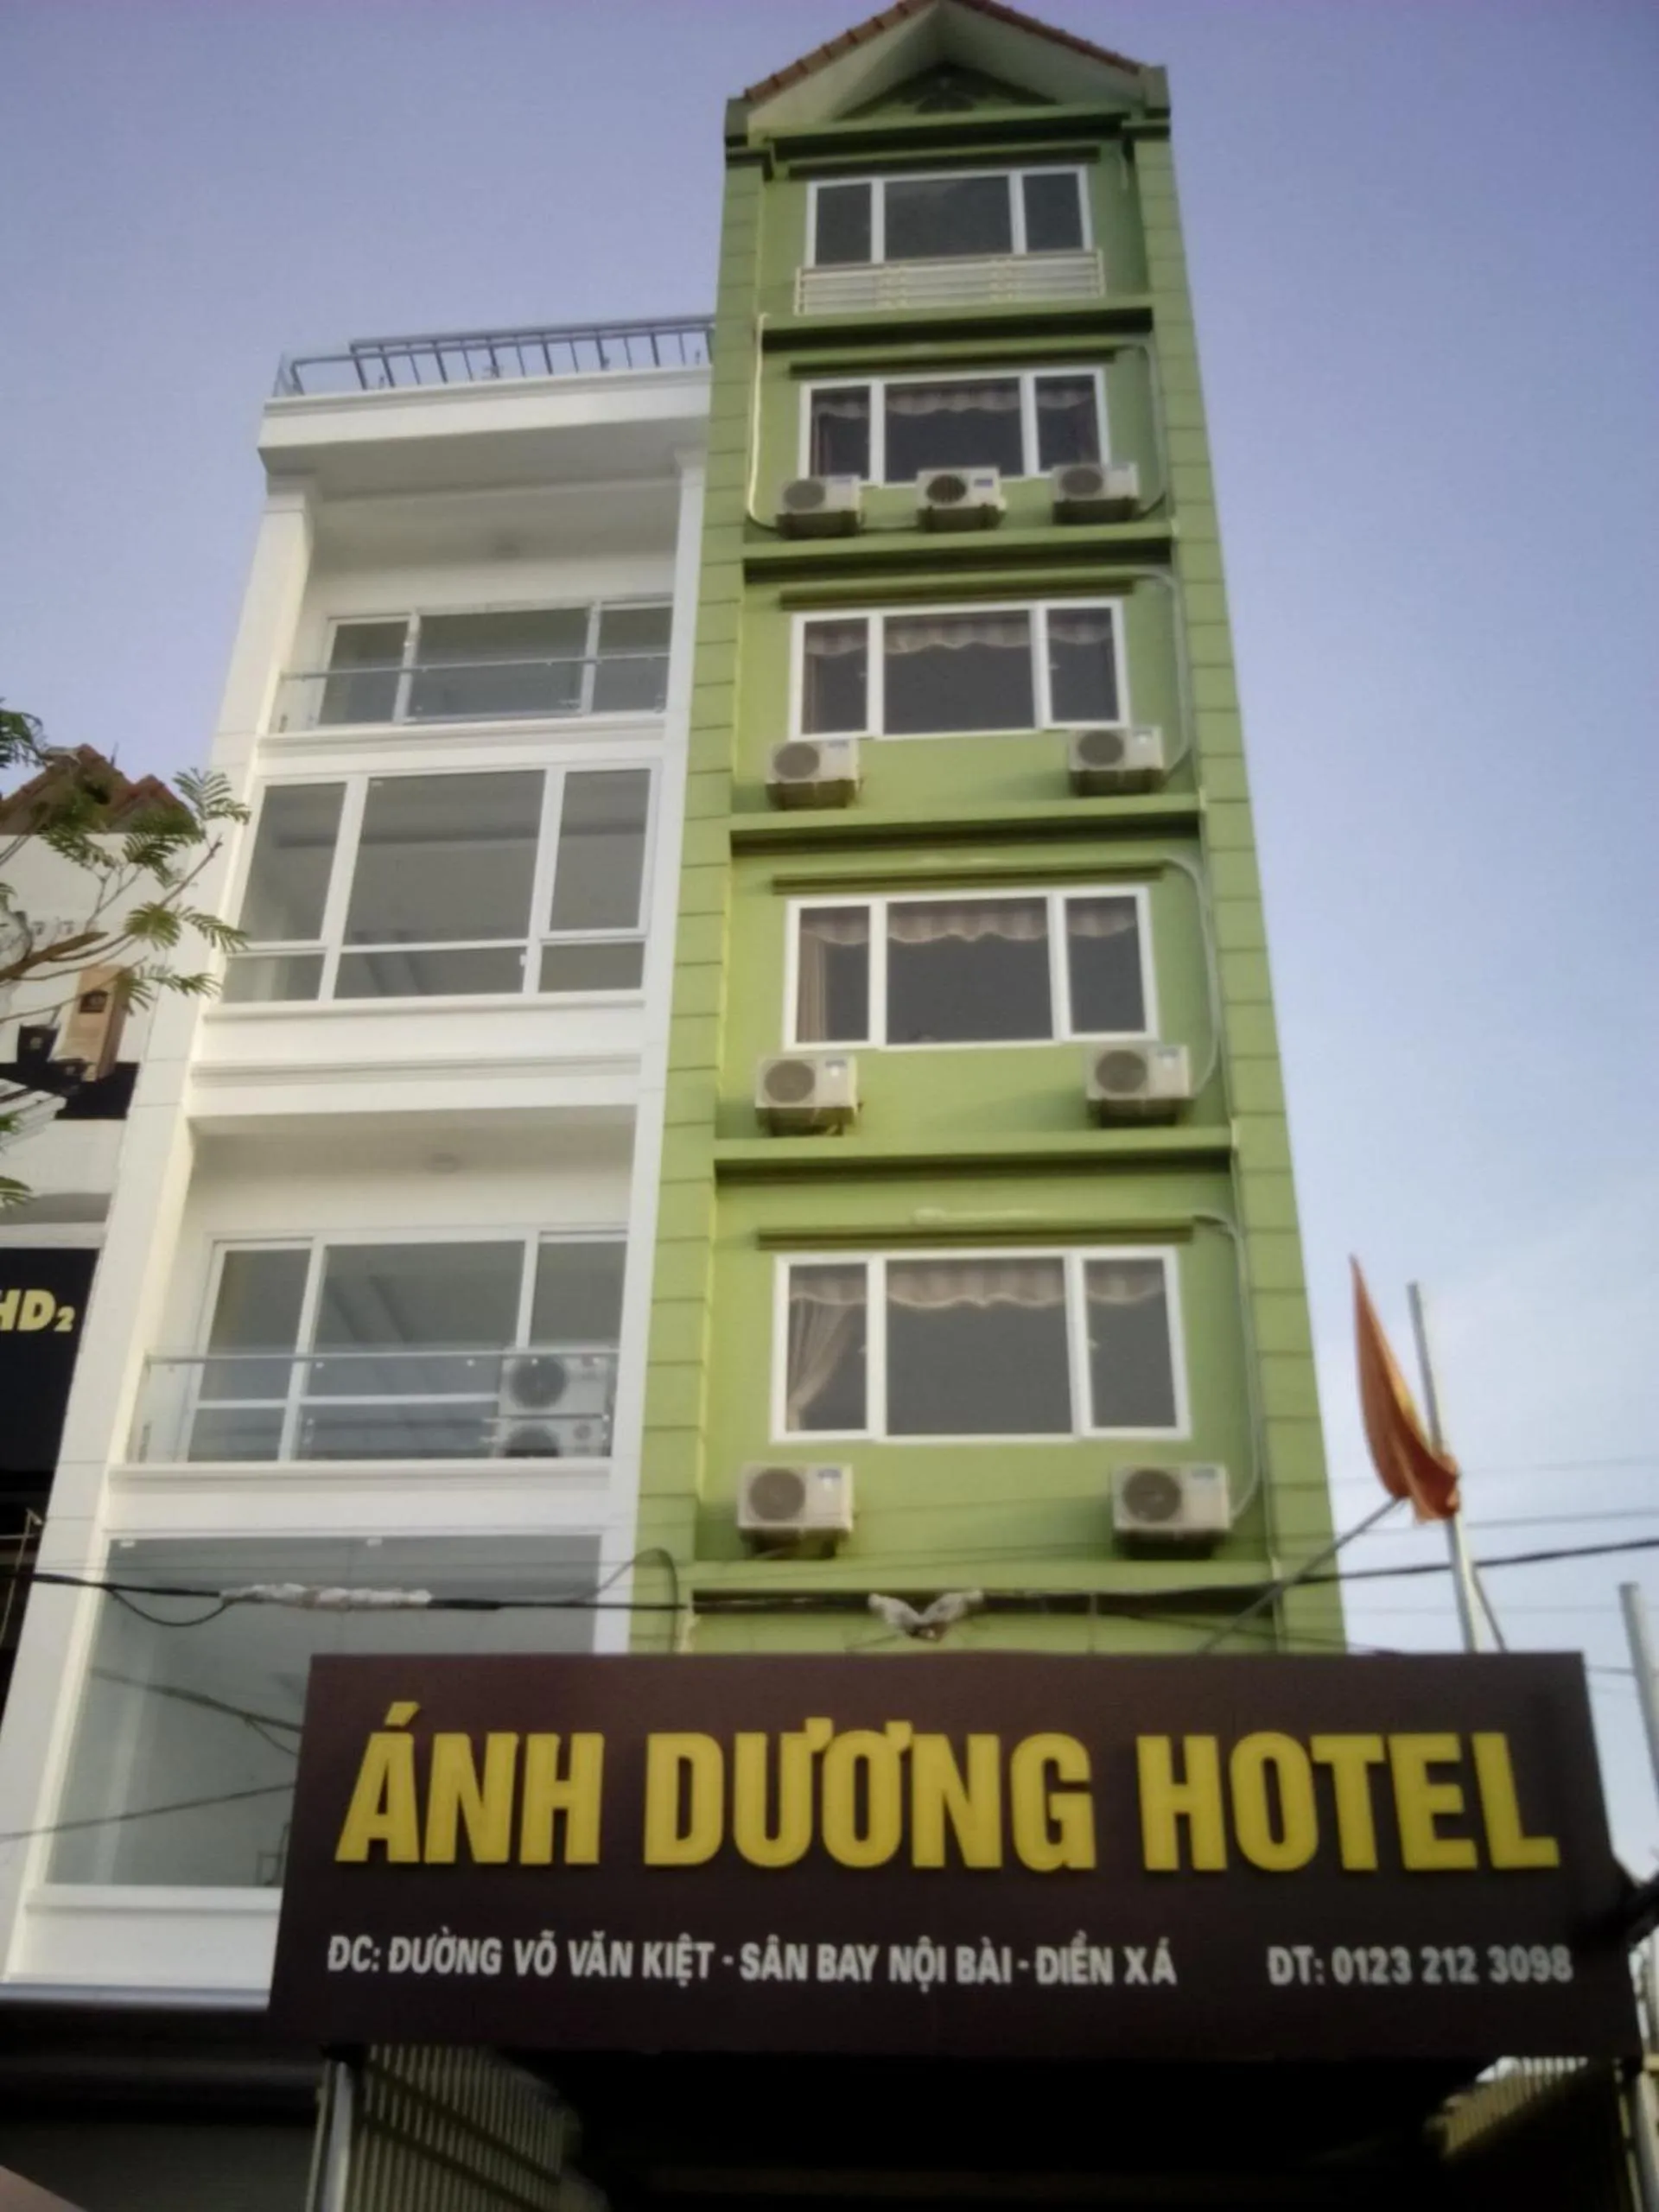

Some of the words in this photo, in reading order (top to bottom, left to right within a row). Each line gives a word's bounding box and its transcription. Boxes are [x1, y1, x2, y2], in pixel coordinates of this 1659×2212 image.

[334, 1700, 605, 1866] ÁNH
[643, 1717, 1096, 1872] DƯƠNG
[1136, 1731, 1560, 1872] HOTEL
[514, 1929, 558, 1978] VÕ
[568, 1929, 633, 1979] VĂN
[642, 1932, 715, 1987] KIỆT
[739, 1934, 809, 1980] SÂN
[817, 1944, 880, 1981] BAY
[888, 1935, 948, 1993] NỘI
[955, 1936, 1013, 1985] BÀI
[1332, 1945, 1414, 1986] 0123
[1421, 1945, 1480, 1985] 212
[1487, 1944, 1574, 1985] 3098
